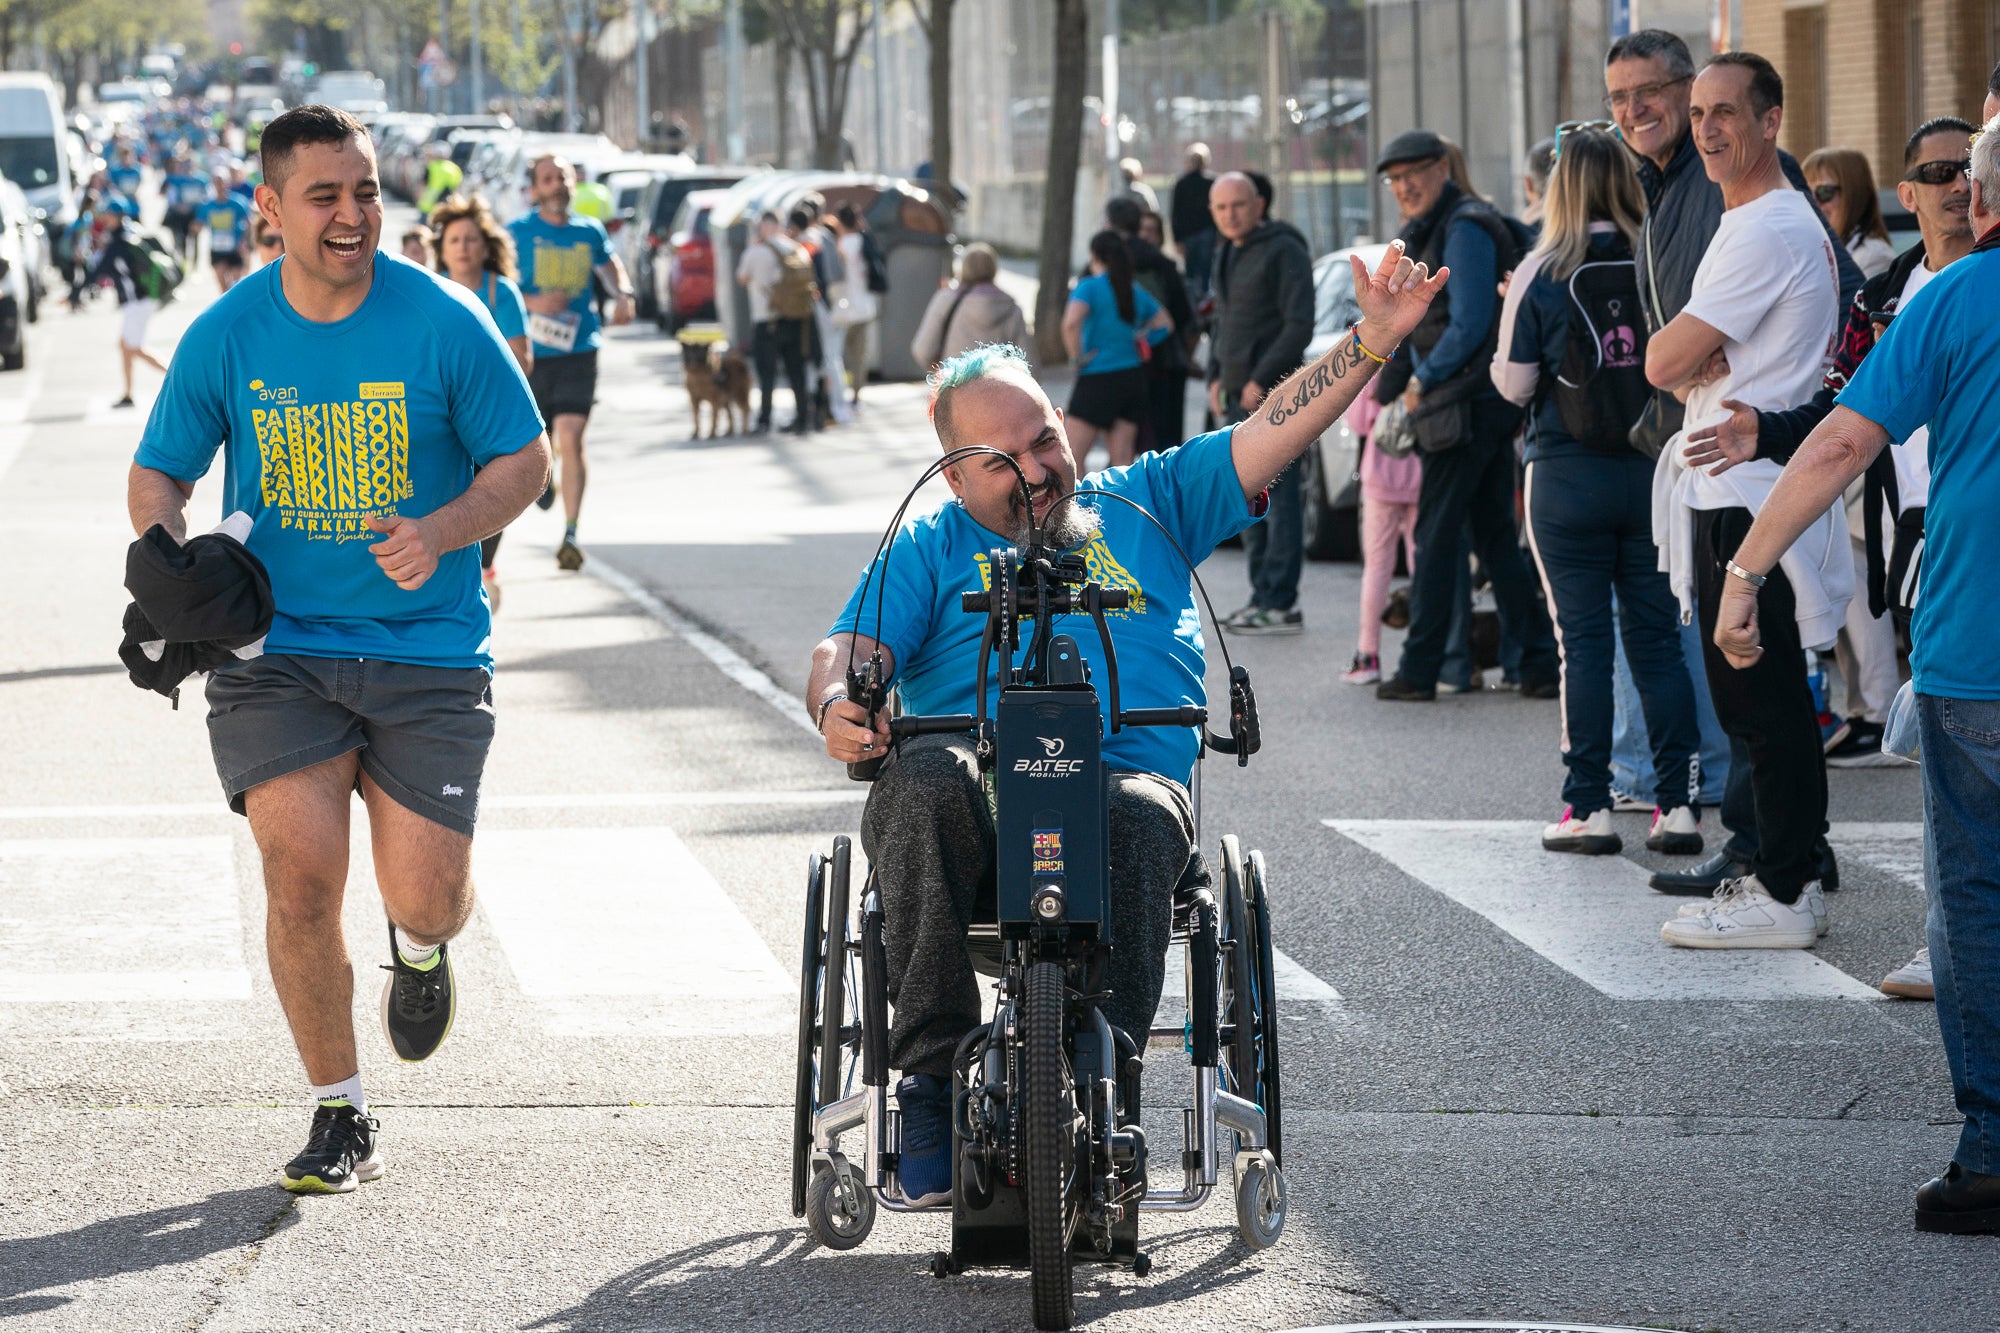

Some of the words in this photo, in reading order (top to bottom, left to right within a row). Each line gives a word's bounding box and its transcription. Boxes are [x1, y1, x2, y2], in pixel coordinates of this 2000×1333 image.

[259, 386, 298, 401] avan
[252, 401, 408, 428] PARKINSON
[281, 509, 295, 517] VIII
[298, 510, 325, 519] CURSA
[327, 511, 331, 519] I
[384, 505, 398, 514] PEL
[1013, 759, 1084, 773] BATEC
[317, 1093, 348, 1102] umbro
